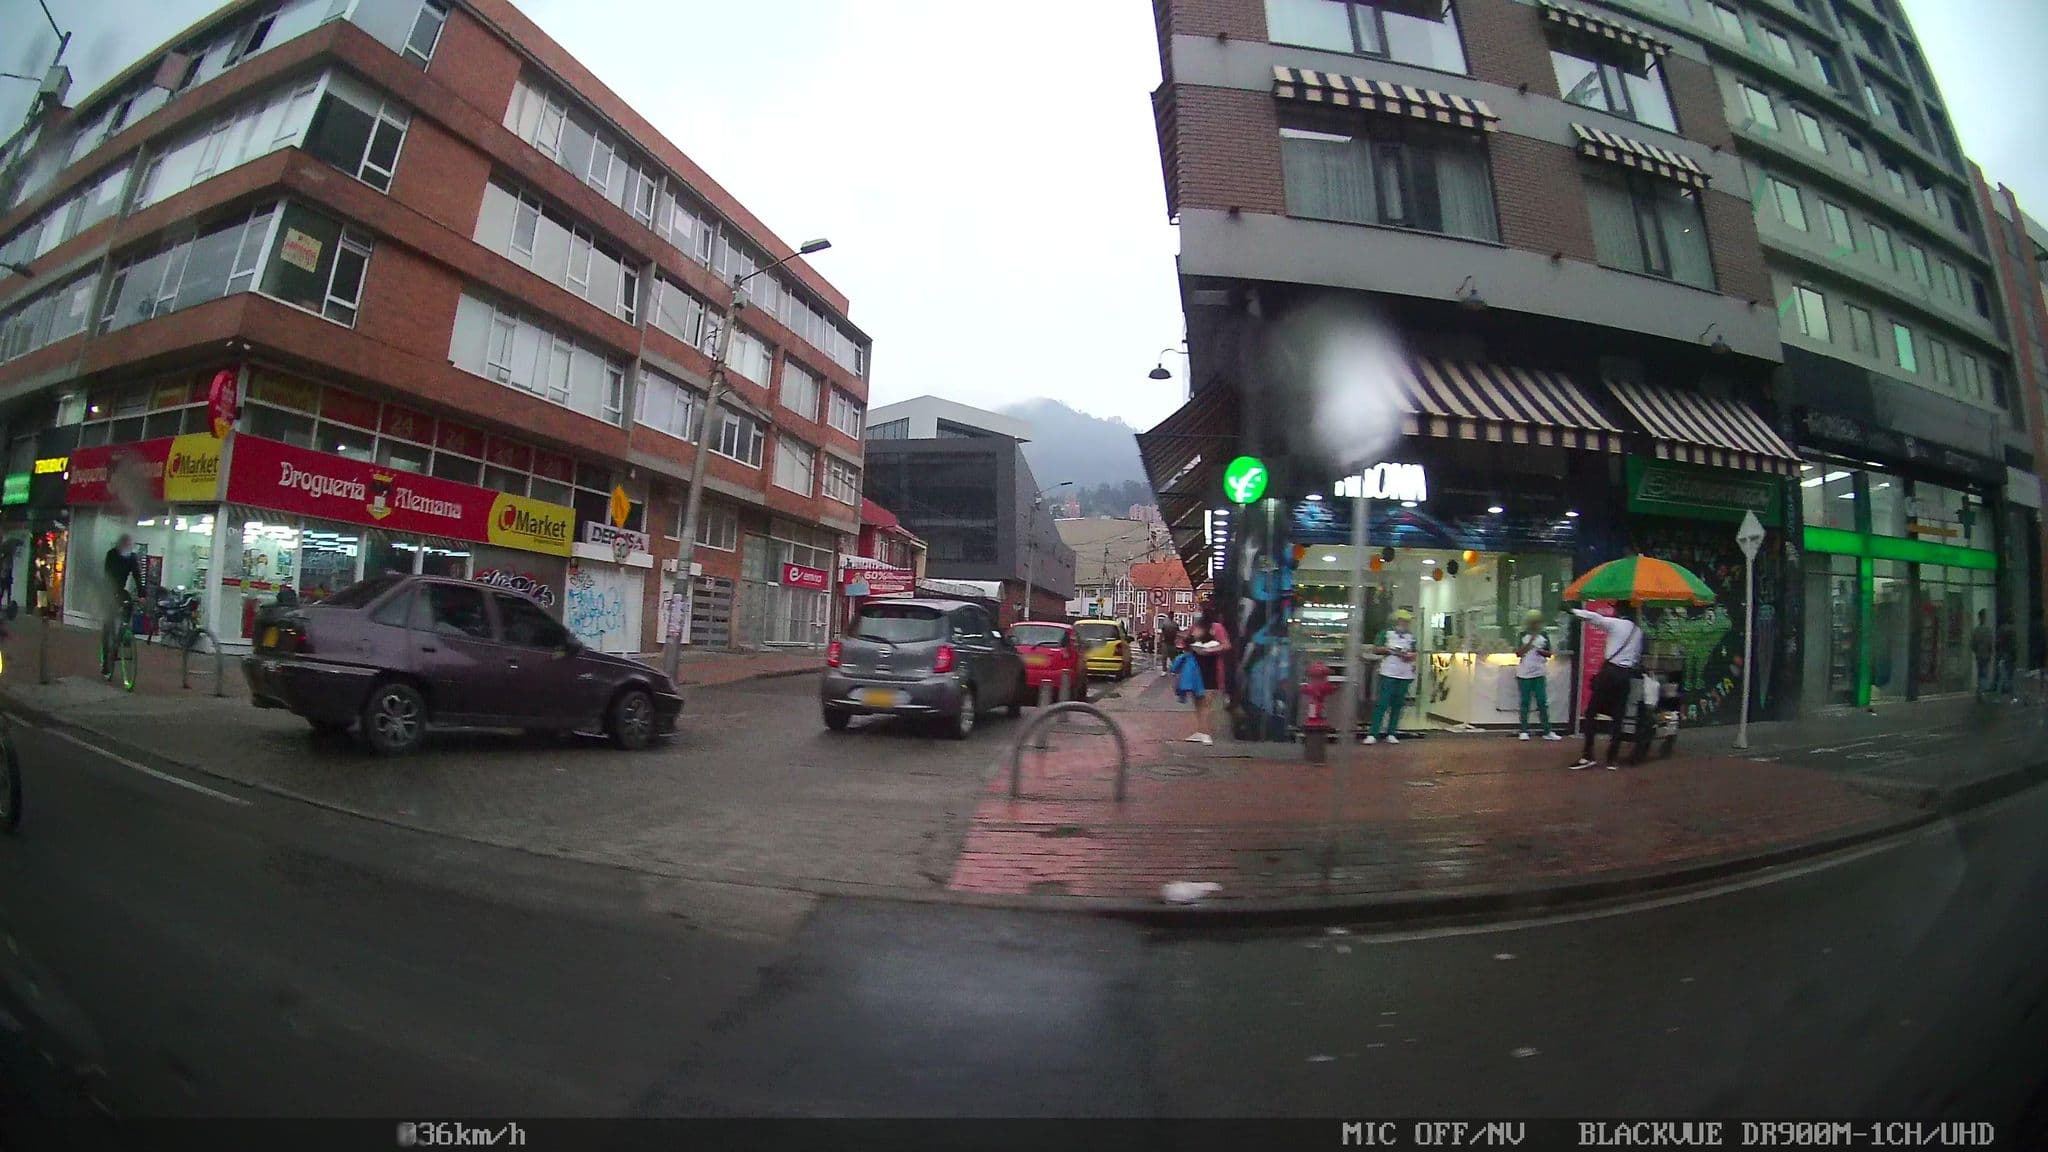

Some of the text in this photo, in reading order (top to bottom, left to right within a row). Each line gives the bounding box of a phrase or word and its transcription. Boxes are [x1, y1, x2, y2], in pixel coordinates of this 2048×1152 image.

[278, 461, 462, 519] Droguería Alemana
[516, 510, 566, 538] Market
[591, 526, 645, 551] DEPSA
